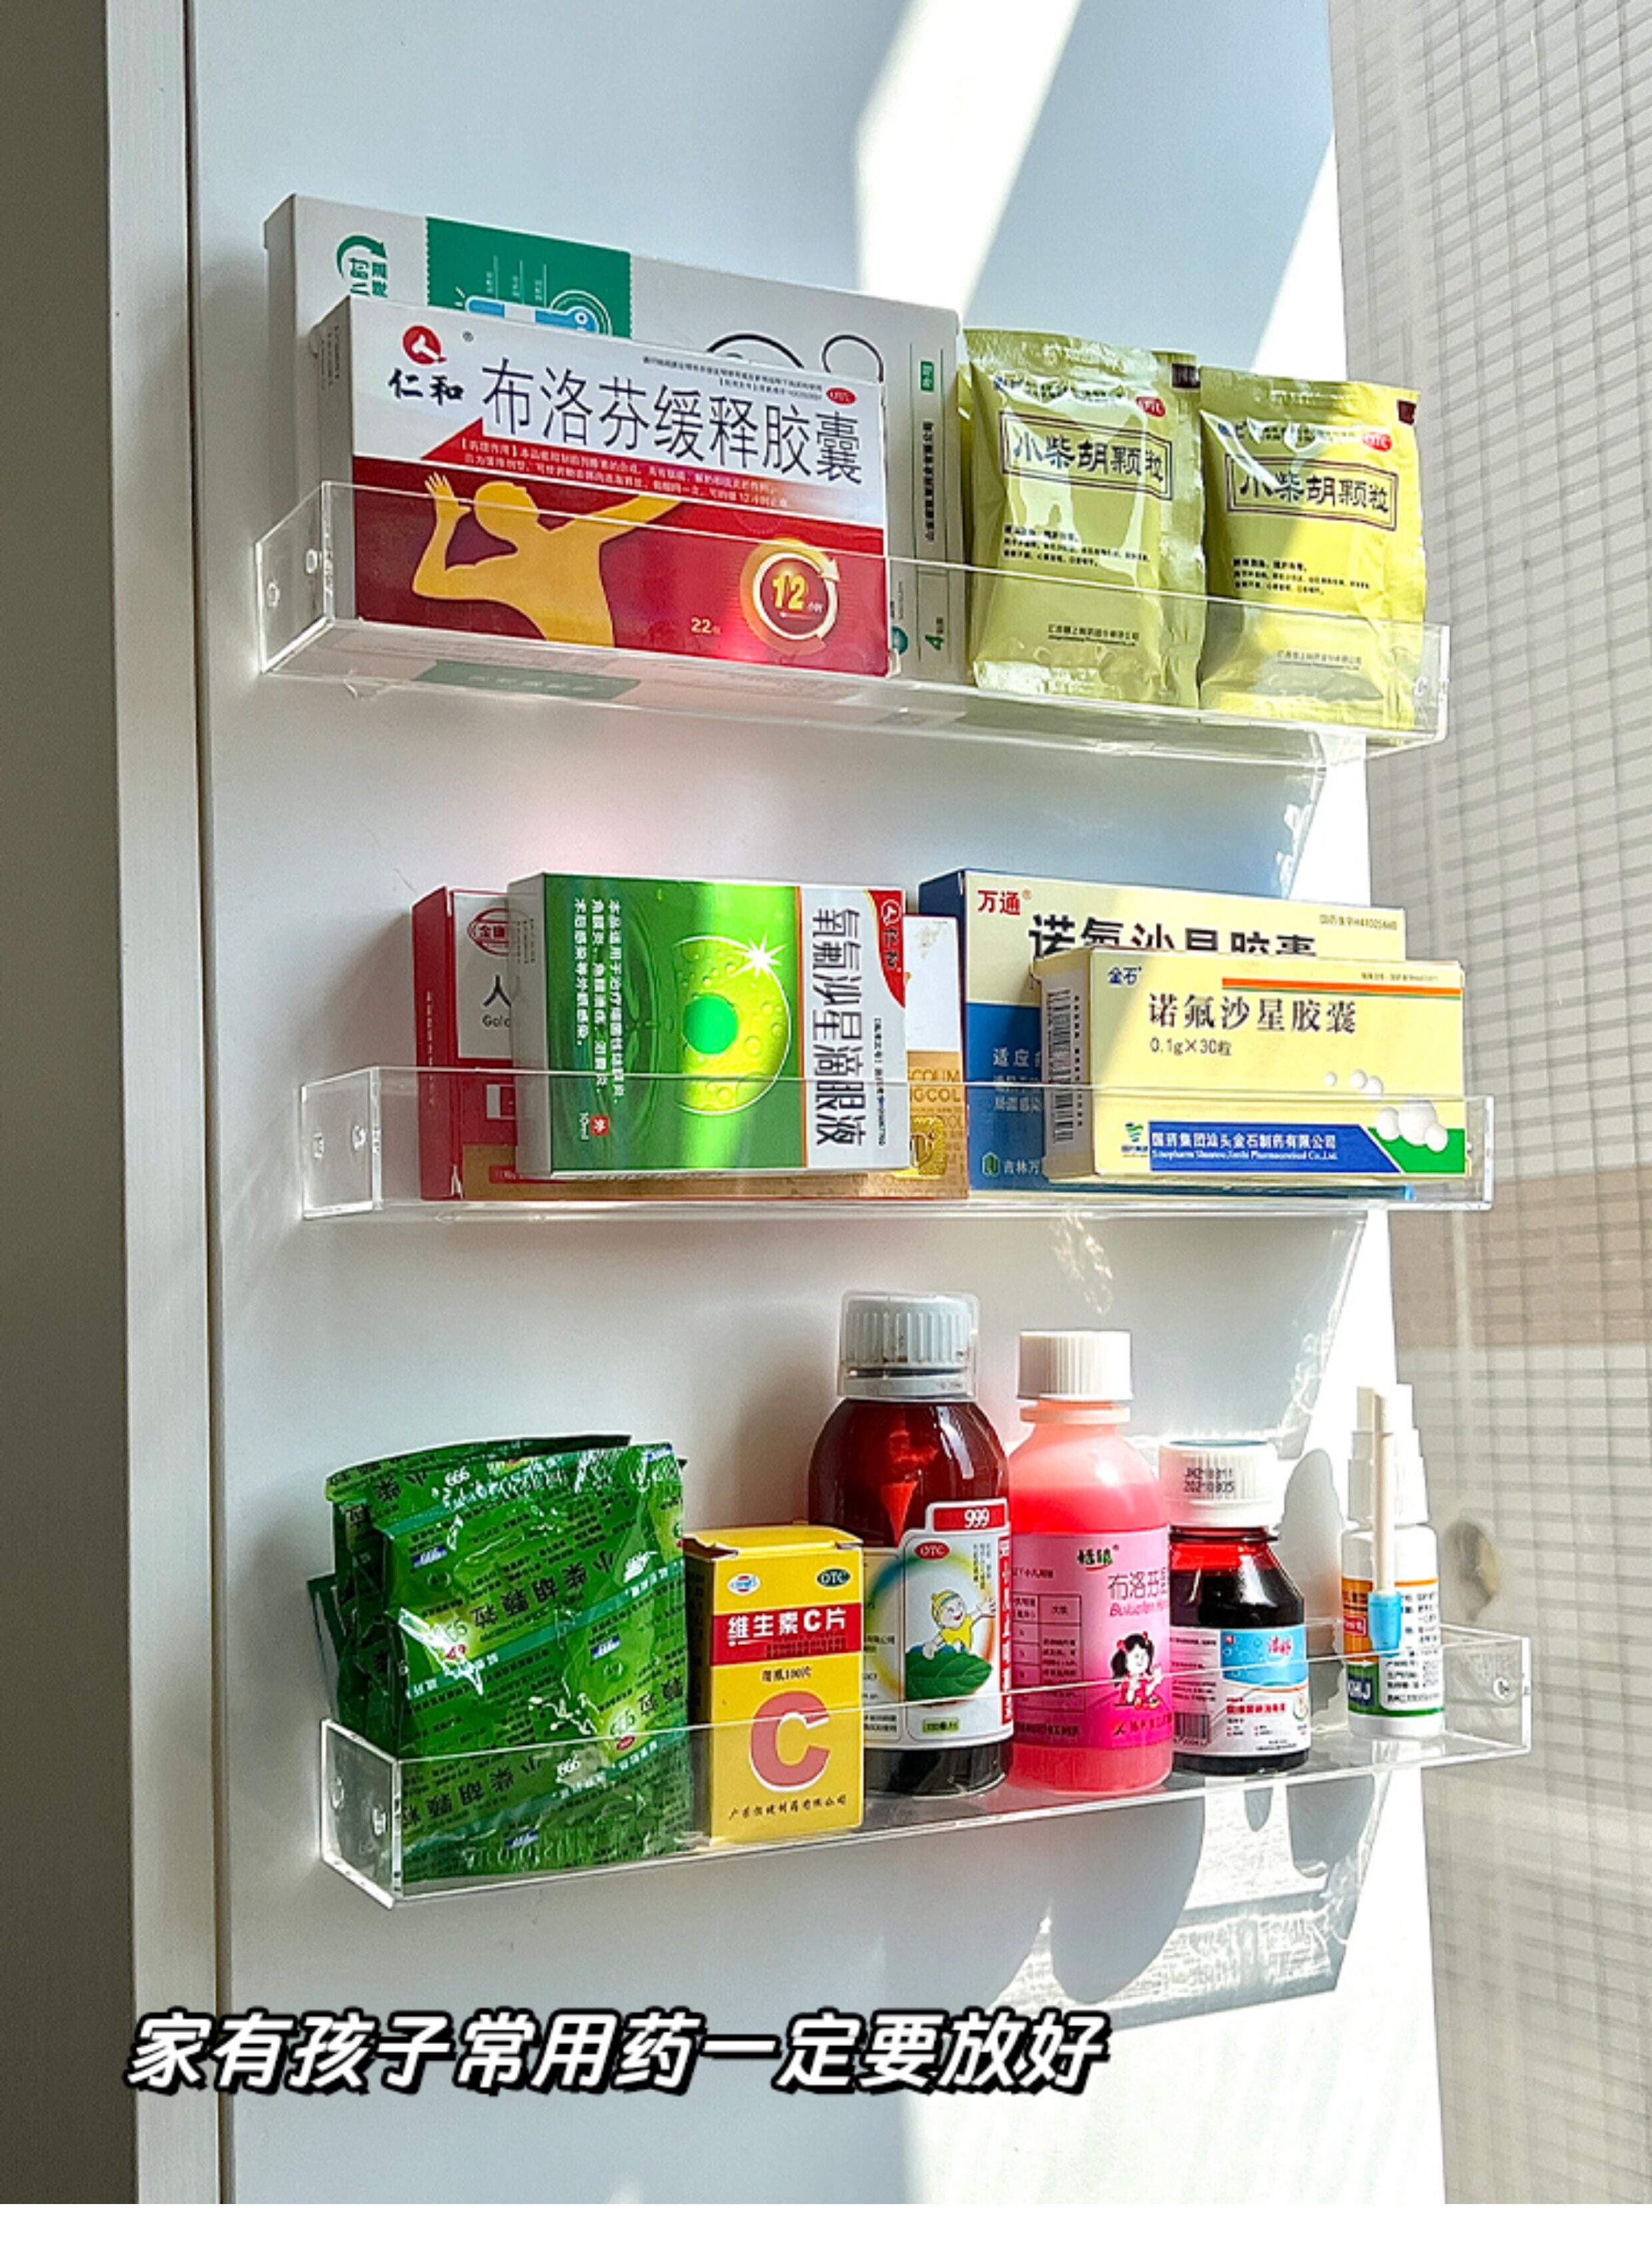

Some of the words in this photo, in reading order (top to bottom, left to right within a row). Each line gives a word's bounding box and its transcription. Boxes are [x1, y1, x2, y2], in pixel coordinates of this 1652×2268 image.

[388, 368, 464, 406] 仁和
[482, 356, 862, 484] 布洛芬缓释胶囊
[1013, 430, 1164, 483] 小柴胡颗粒
[1239, 470, 1389, 514] 小柴胡颗粒
[771, 574, 808, 610] 12
[977, 889, 1021, 915] 万通
[1108, 966, 1140, 985] 金石
[812, 908, 867, 1147] 氧氟沙星滴眼液
[1148, 992, 1356, 1035] 诺氟沙星胶囊
[909, 1088, 961, 1103] GCOL
[964, 1508, 991, 1528] 999
[727, 1606, 847, 1642] 维生素C片
[749, 1690, 831, 1792] C
